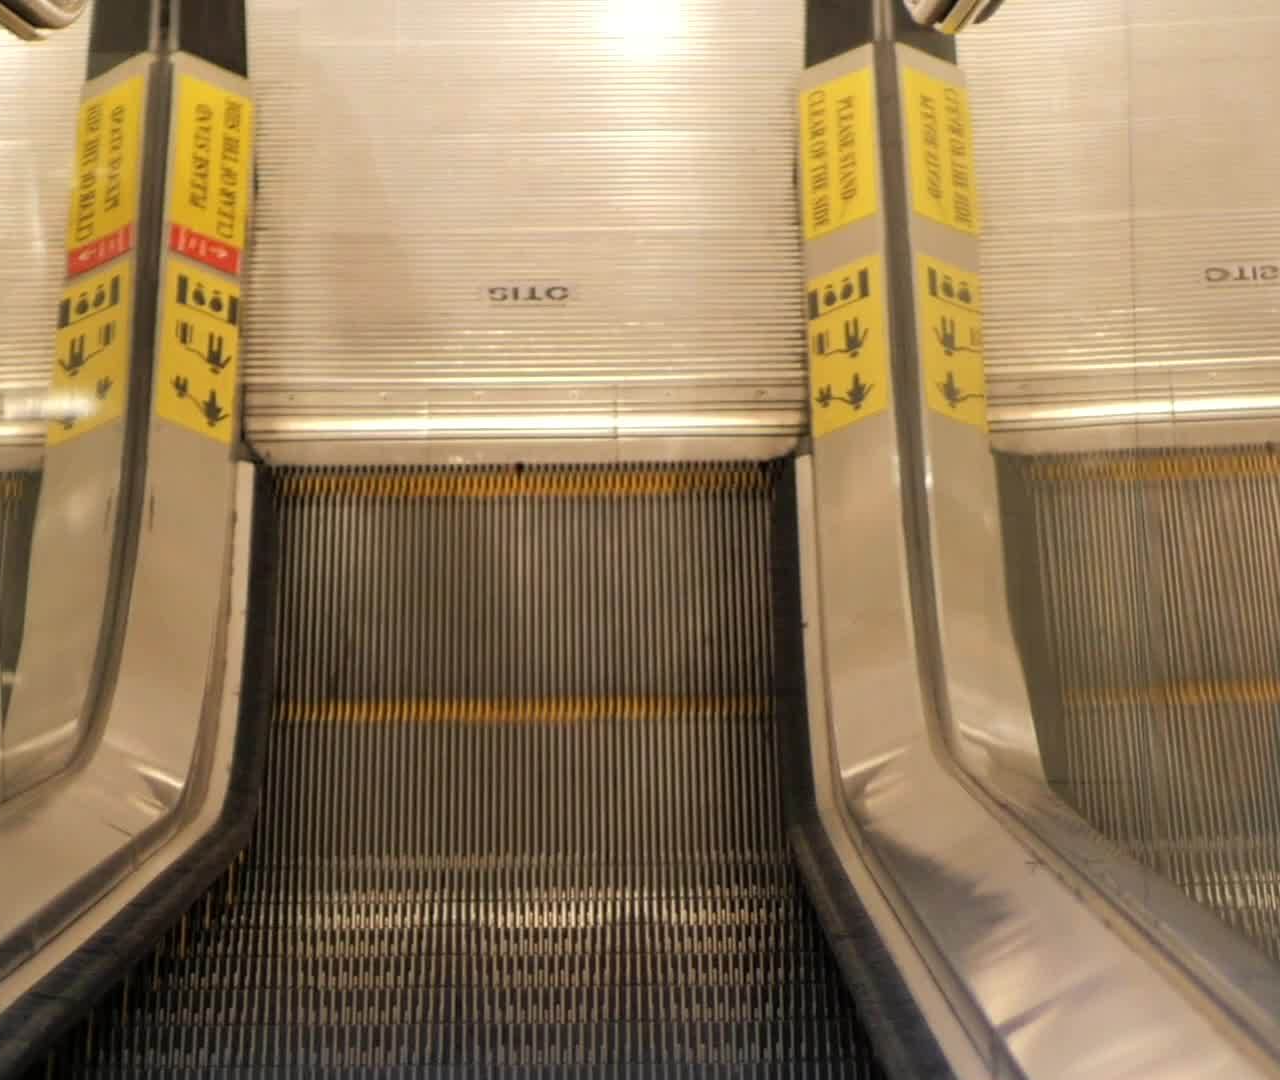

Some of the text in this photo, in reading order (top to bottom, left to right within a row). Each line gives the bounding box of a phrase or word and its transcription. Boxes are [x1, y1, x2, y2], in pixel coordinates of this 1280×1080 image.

[188, 103, 213, 209] PLEASE STAND
[216, 98, 242, 239] CLEAR OF THE SIDE
[807, 89, 831, 227] CLEAR OF THE SIDE
[838, 95, 857, 201] PLEASE STAND
[486, 286, 569, 302] OTIS
